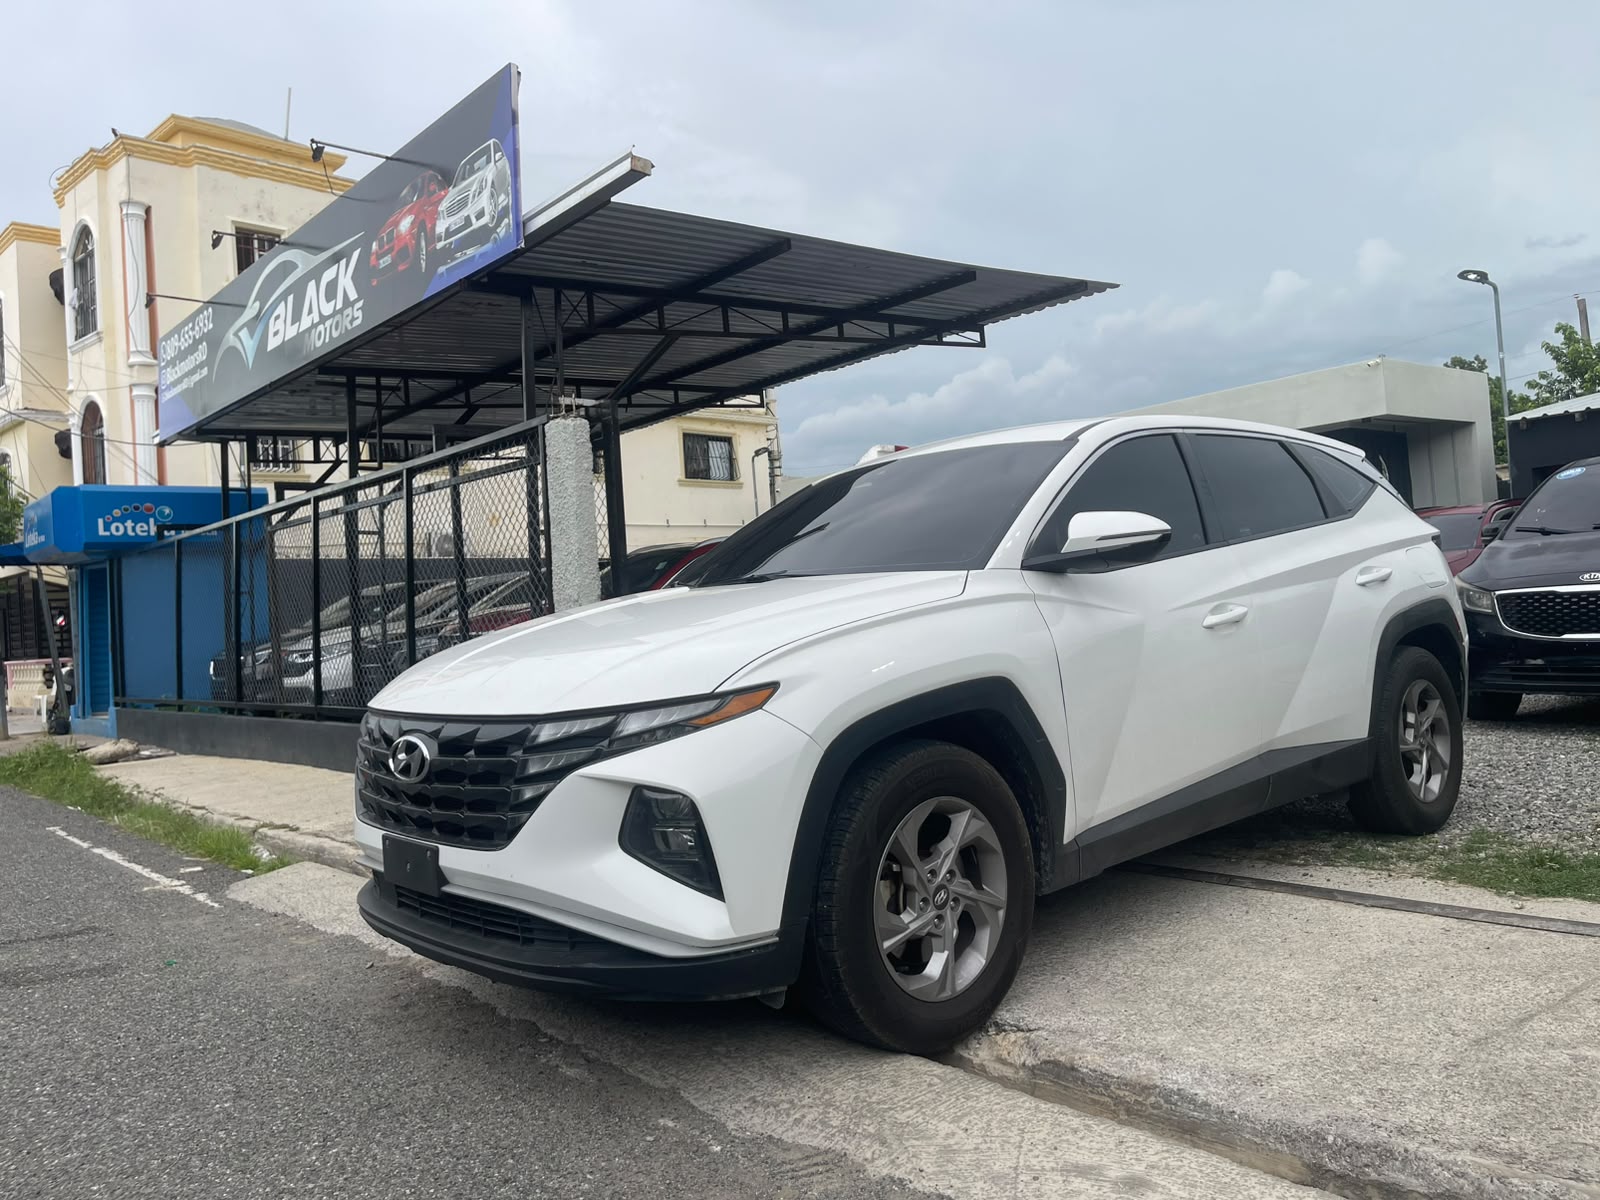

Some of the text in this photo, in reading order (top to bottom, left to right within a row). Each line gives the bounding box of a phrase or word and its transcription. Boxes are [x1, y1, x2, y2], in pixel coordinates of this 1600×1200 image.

[267, 247, 361, 352] BLACK
[303, 299, 364, 355] MOTORS
[166, 306, 213, 360] 809-655-6932
